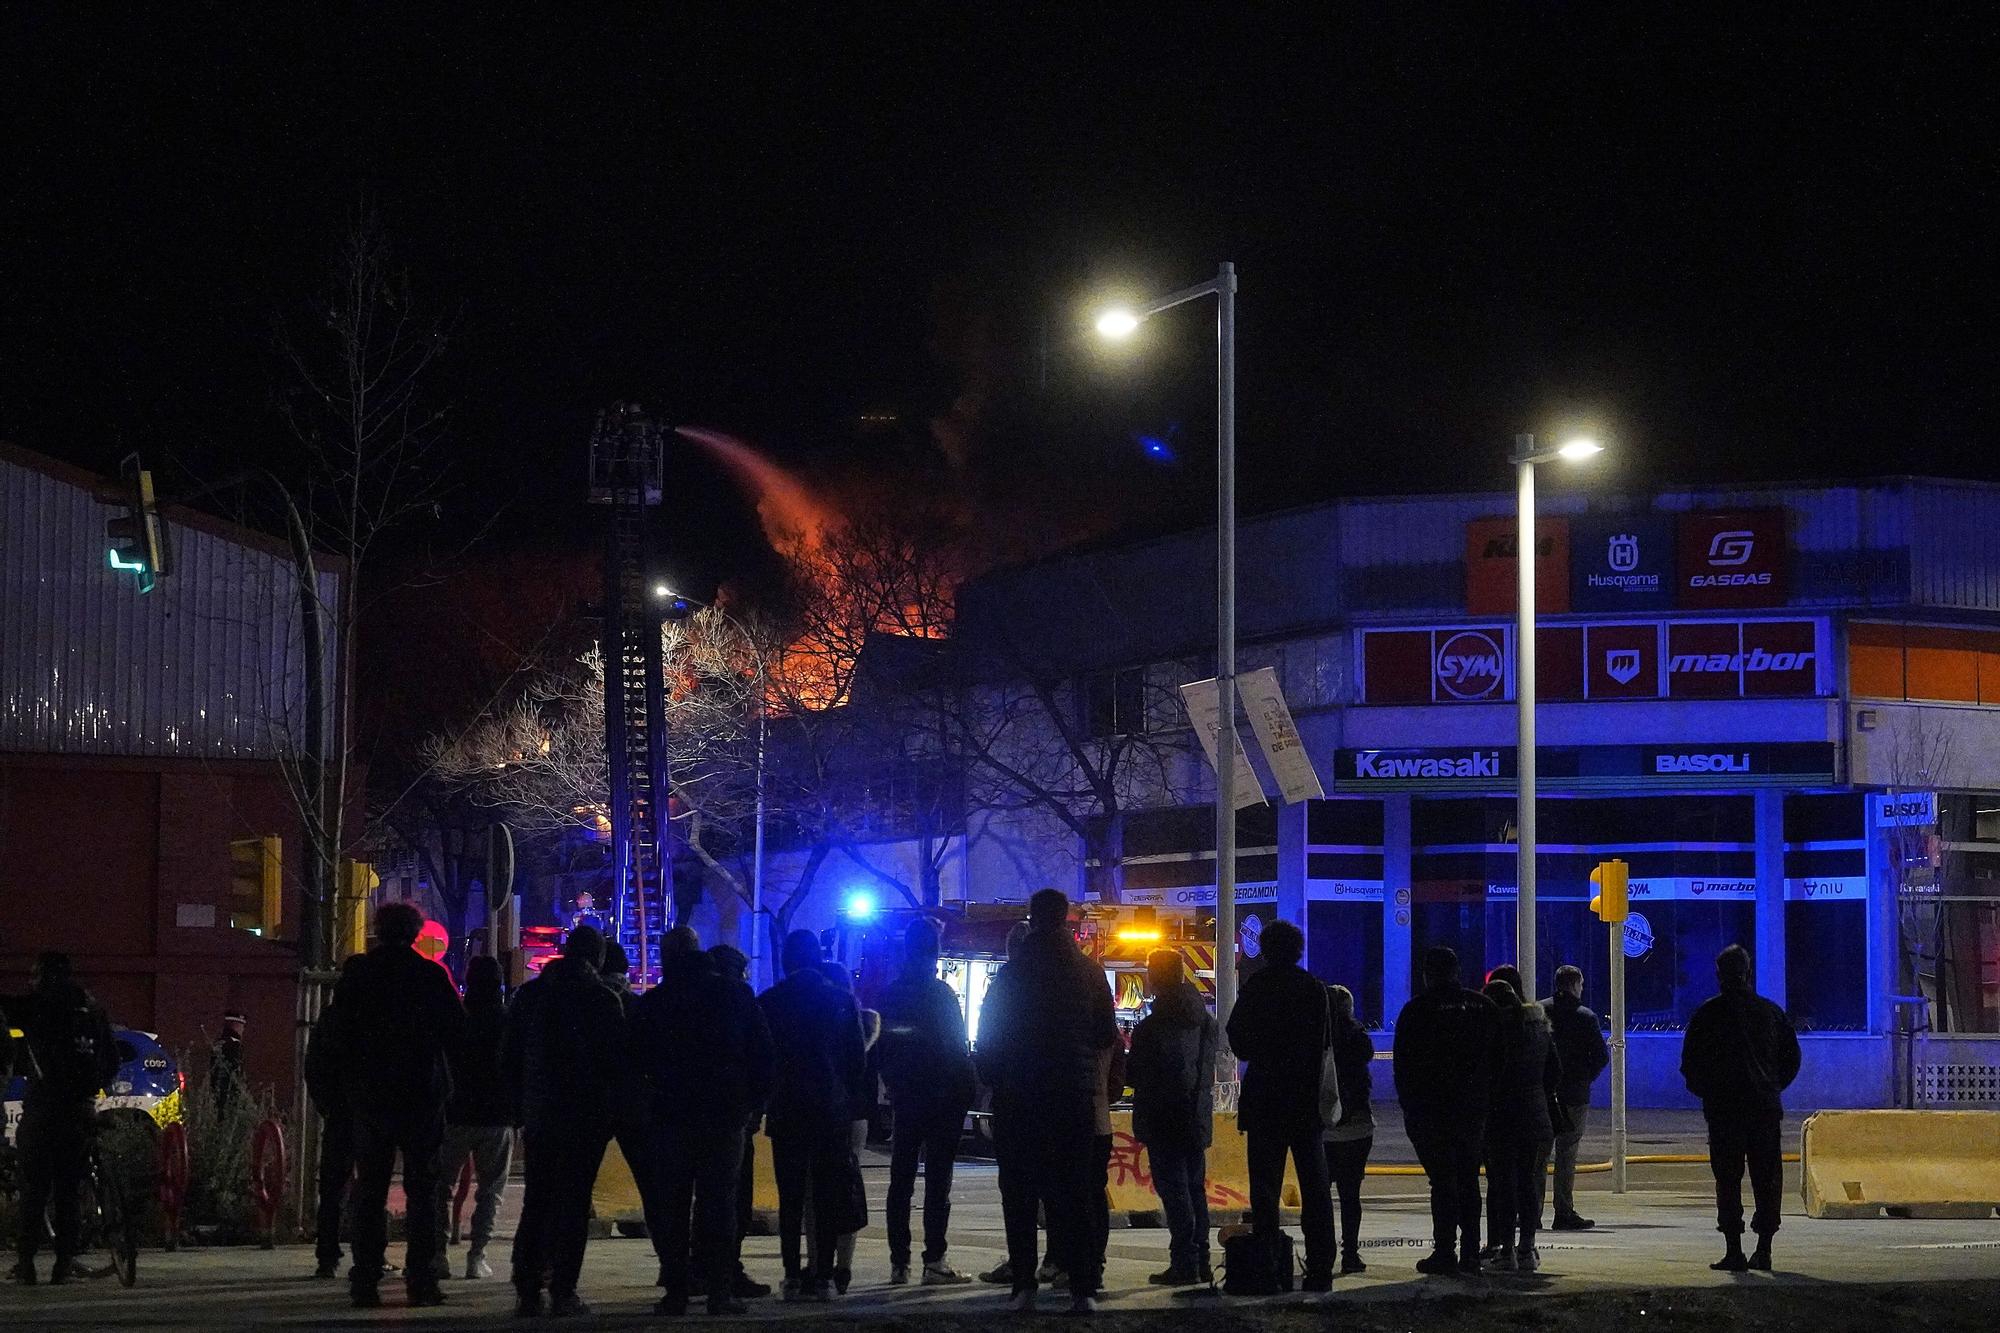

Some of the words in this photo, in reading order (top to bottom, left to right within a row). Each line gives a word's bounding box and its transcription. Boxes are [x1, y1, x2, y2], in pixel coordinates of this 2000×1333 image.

[1587, 573, 1659, 591] Husqvarna
[1689, 573, 1773, 587] GASGAS
[1669, 647, 1815, 673] macbor
[1440, 654, 1500, 684] SYM
[1356, 751, 1499, 777] Kawasaki
[1345, 885, 1384, 895] Husqvarn
[1488, 884, 1518, 894] Kawas
[1628, 883, 1650, 898] SYM
[1706, 882, 1757, 892] macbo
